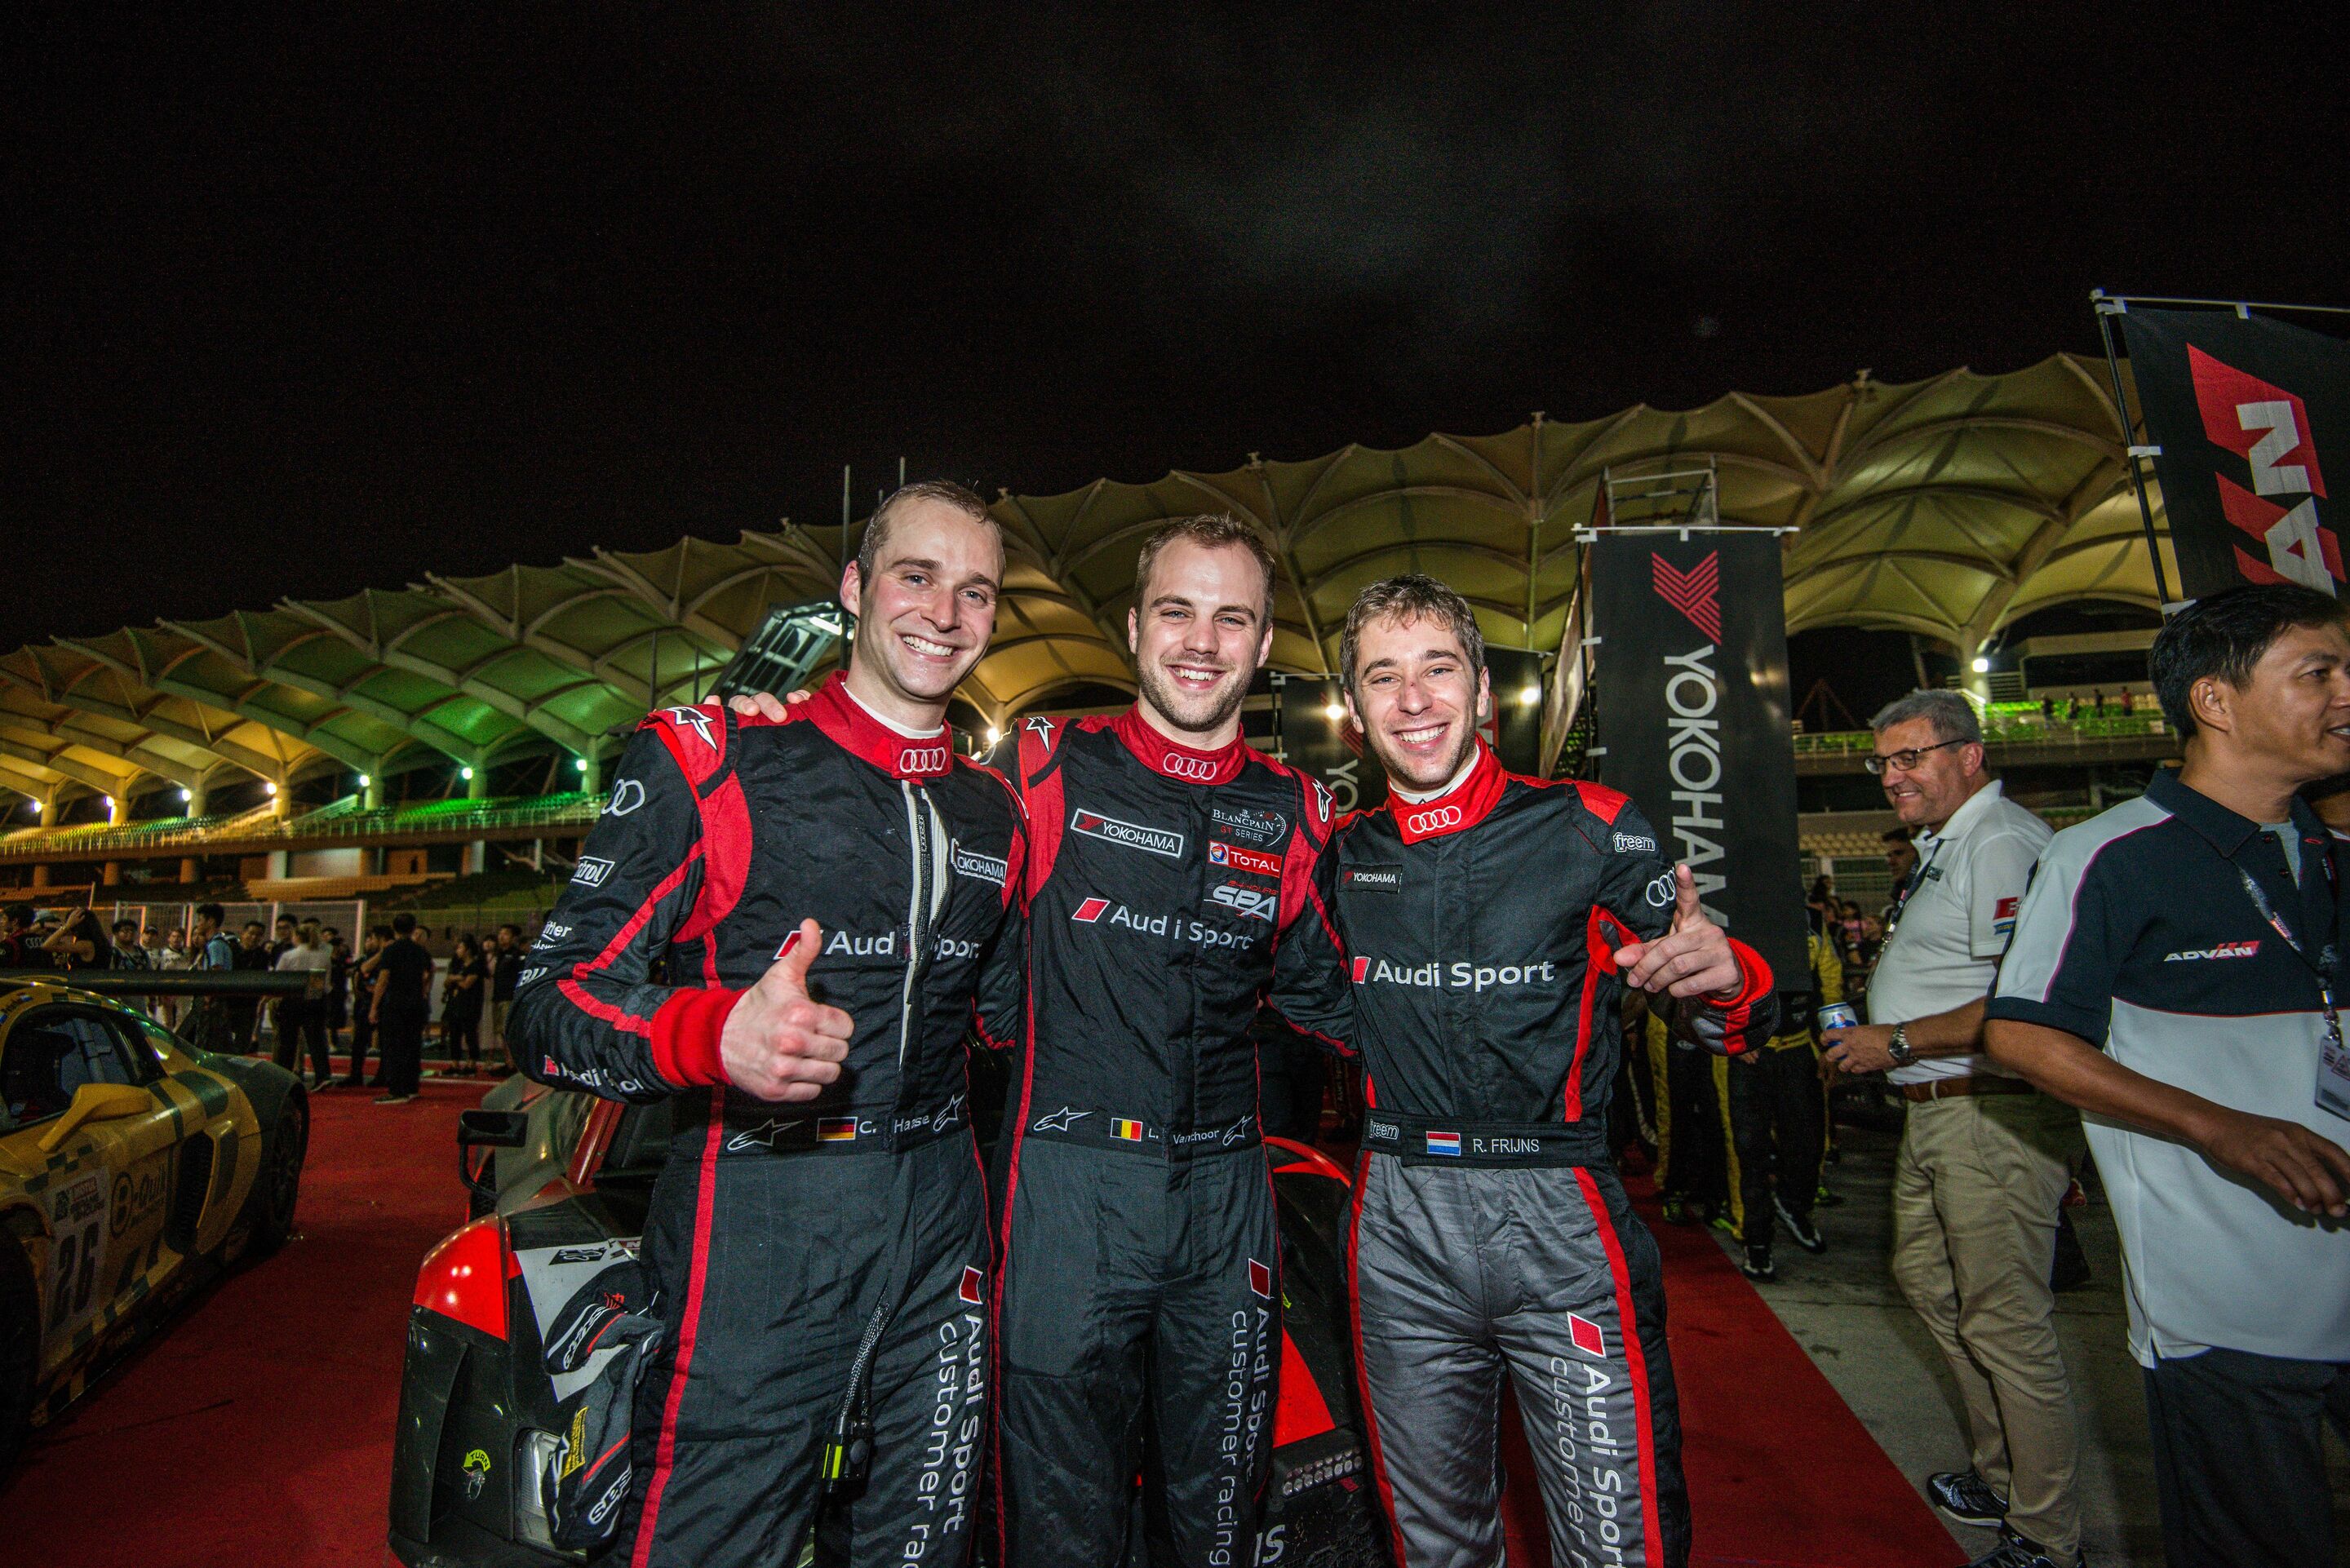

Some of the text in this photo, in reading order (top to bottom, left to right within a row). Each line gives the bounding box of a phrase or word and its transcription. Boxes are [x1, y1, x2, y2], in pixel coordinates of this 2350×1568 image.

[1665, 644, 1729, 928] YOKOHAM
[1213, 808, 1274, 831] BLANCPAIN
[1102, 821, 1175, 852] YOKOHAMA
[1235, 828, 1263, 842] SERIES
[574, 860, 606, 882] trol
[956, 855, 1004, 879] OKOHAMA
[1230, 851, 1279, 872] TOTAL
[1353, 872, 1396, 884] YOKOHAMA
[1212, 885, 1276, 923] SPA
[825, 931, 896, 955] Aud
[1188, 922, 1254, 950] Sport
[2163, 946, 2252, 962] ADVAN
[1373, 959, 1555, 993] Audi Sport
[859, 1115, 930, 1134] C. Haase
[1148, 1127, 1159, 1139] L.
[1473, 1138, 1540, 1153] R. FRIJNS
[1245, 1307, 1270, 1483] Audi Sport
[917, 1322, 959, 1511] customer
[1583, 1363, 1619, 1456] Audi
[942, 1314, 984, 1534] Audi Sport
[1209, 1310, 1248, 1566] customer racing
[470, 1451, 490, 1468] TURN
[1550, 1356, 1585, 1546] customer
